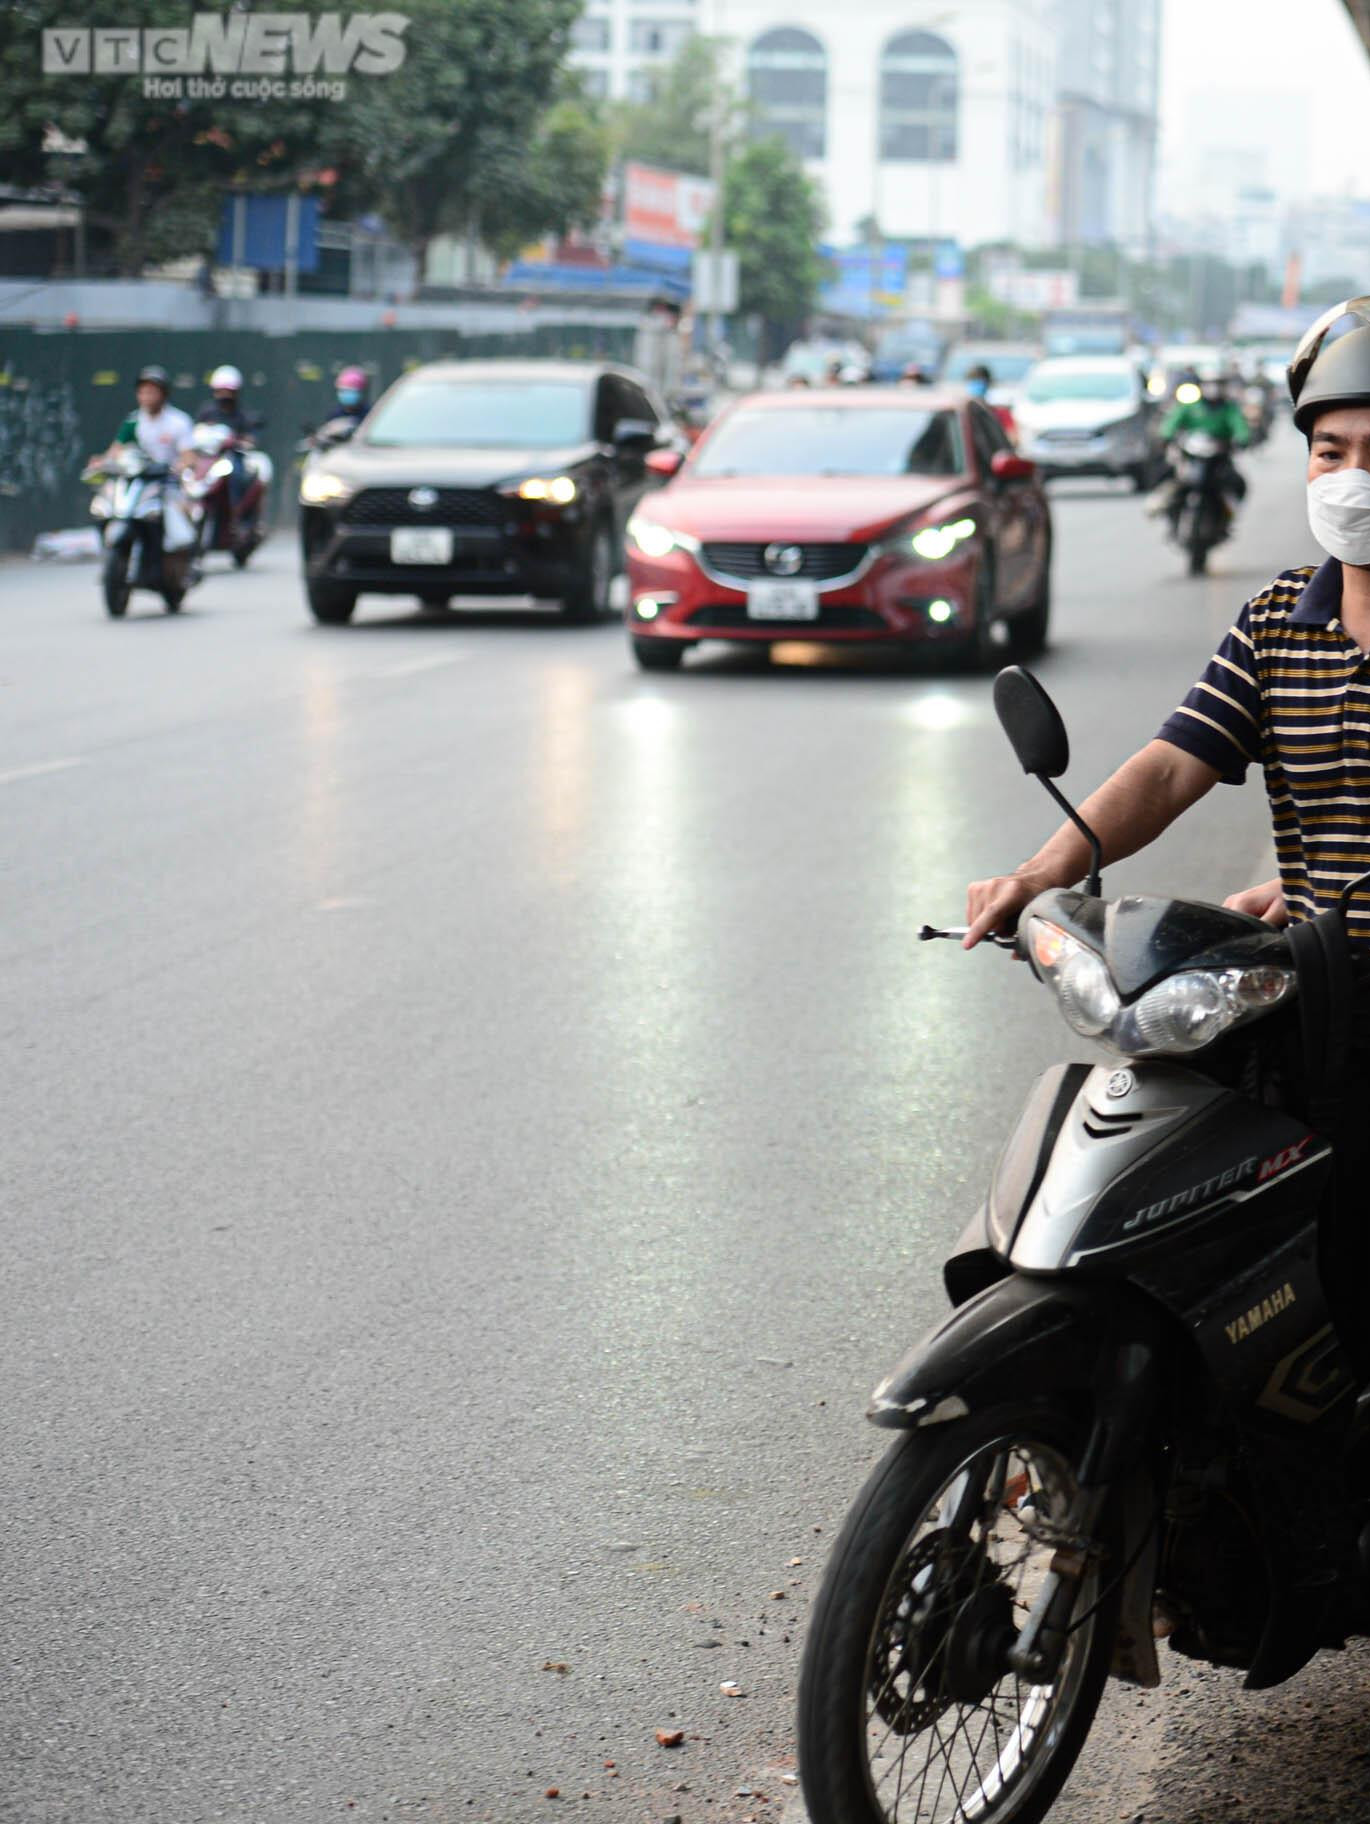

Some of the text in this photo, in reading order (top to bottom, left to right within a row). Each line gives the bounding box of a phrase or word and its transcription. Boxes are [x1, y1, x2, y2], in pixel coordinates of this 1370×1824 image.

[1123, 1133, 1314, 1229] JUPITER MX
[1225, 1282, 1296, 1345] YAMAHA
